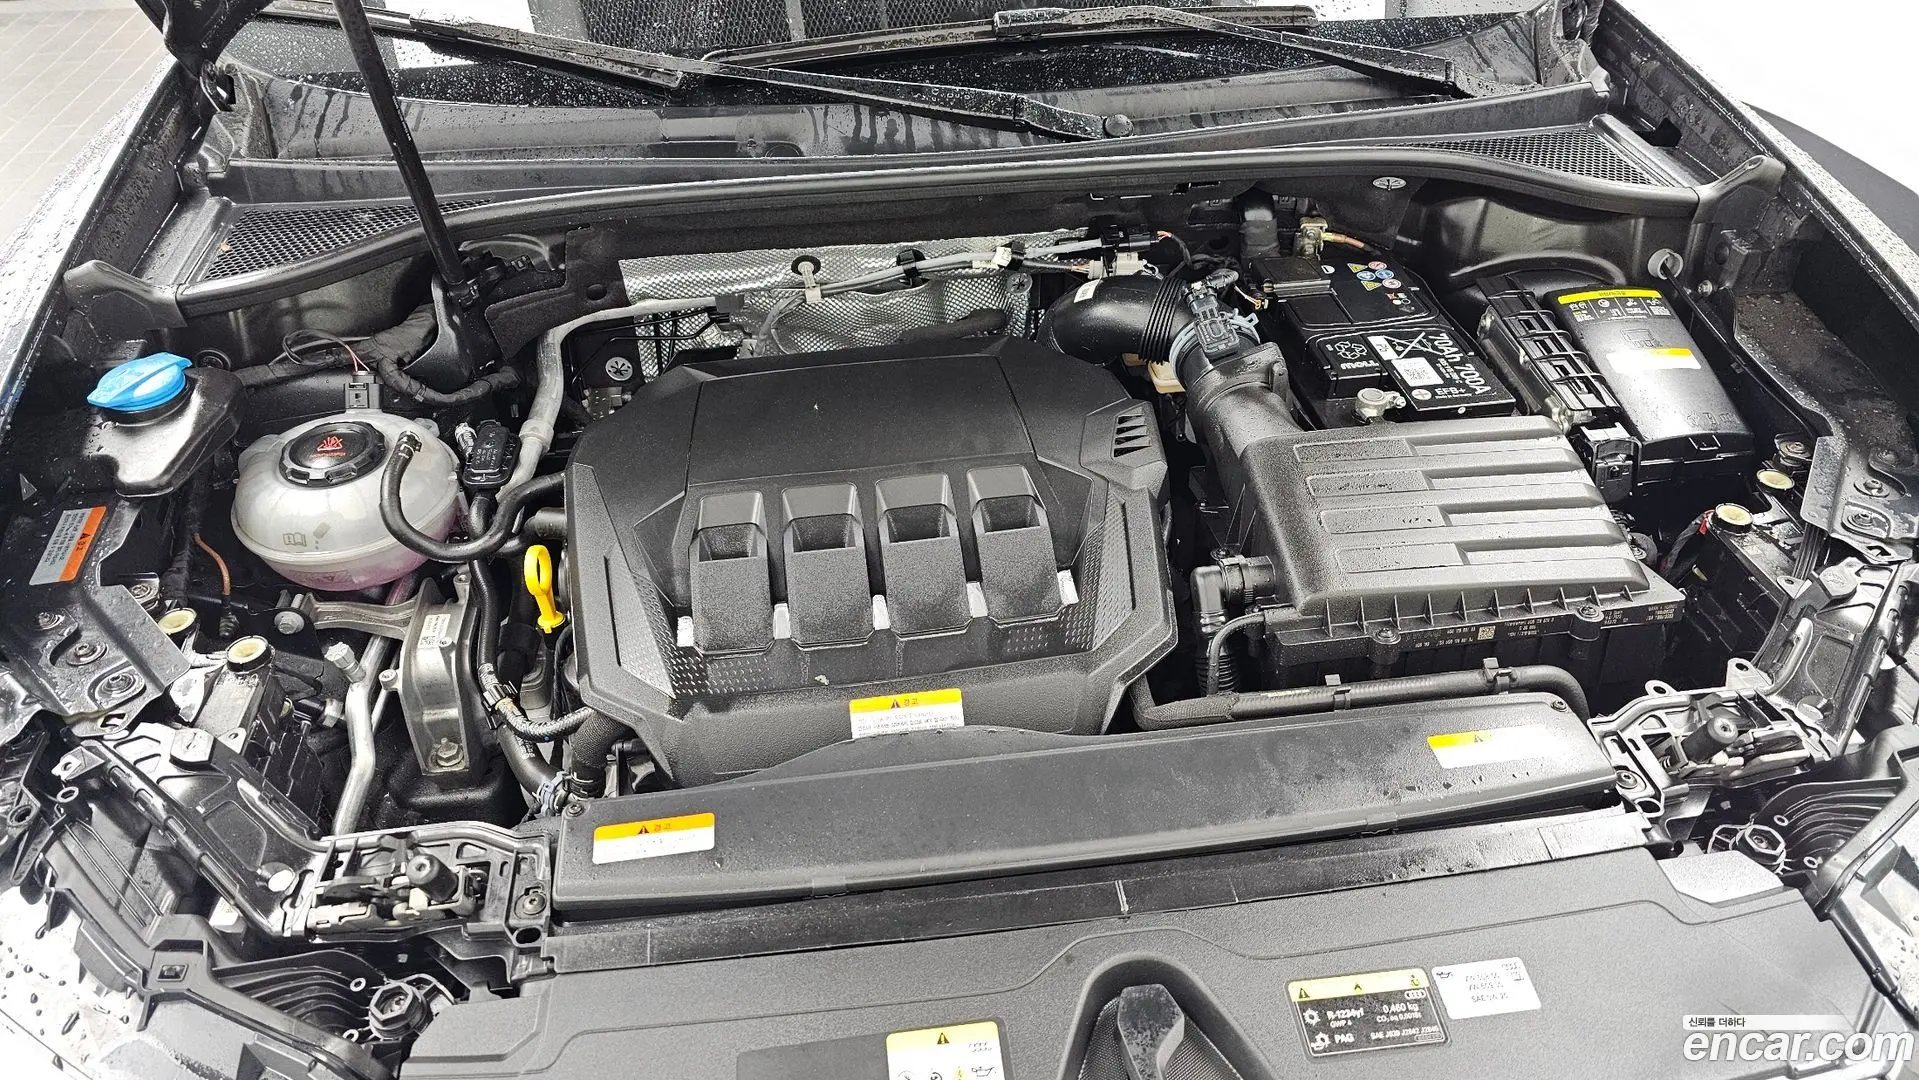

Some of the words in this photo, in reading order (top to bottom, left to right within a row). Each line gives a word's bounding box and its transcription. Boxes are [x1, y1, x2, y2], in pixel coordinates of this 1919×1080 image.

[1428, 333, 1464, 362] 70Ah
[1454, 364, 1492, 395] 700A
[1407, 1002, 1419, 1012] kg
[1334, 1033, 1355, 1044] PAG
